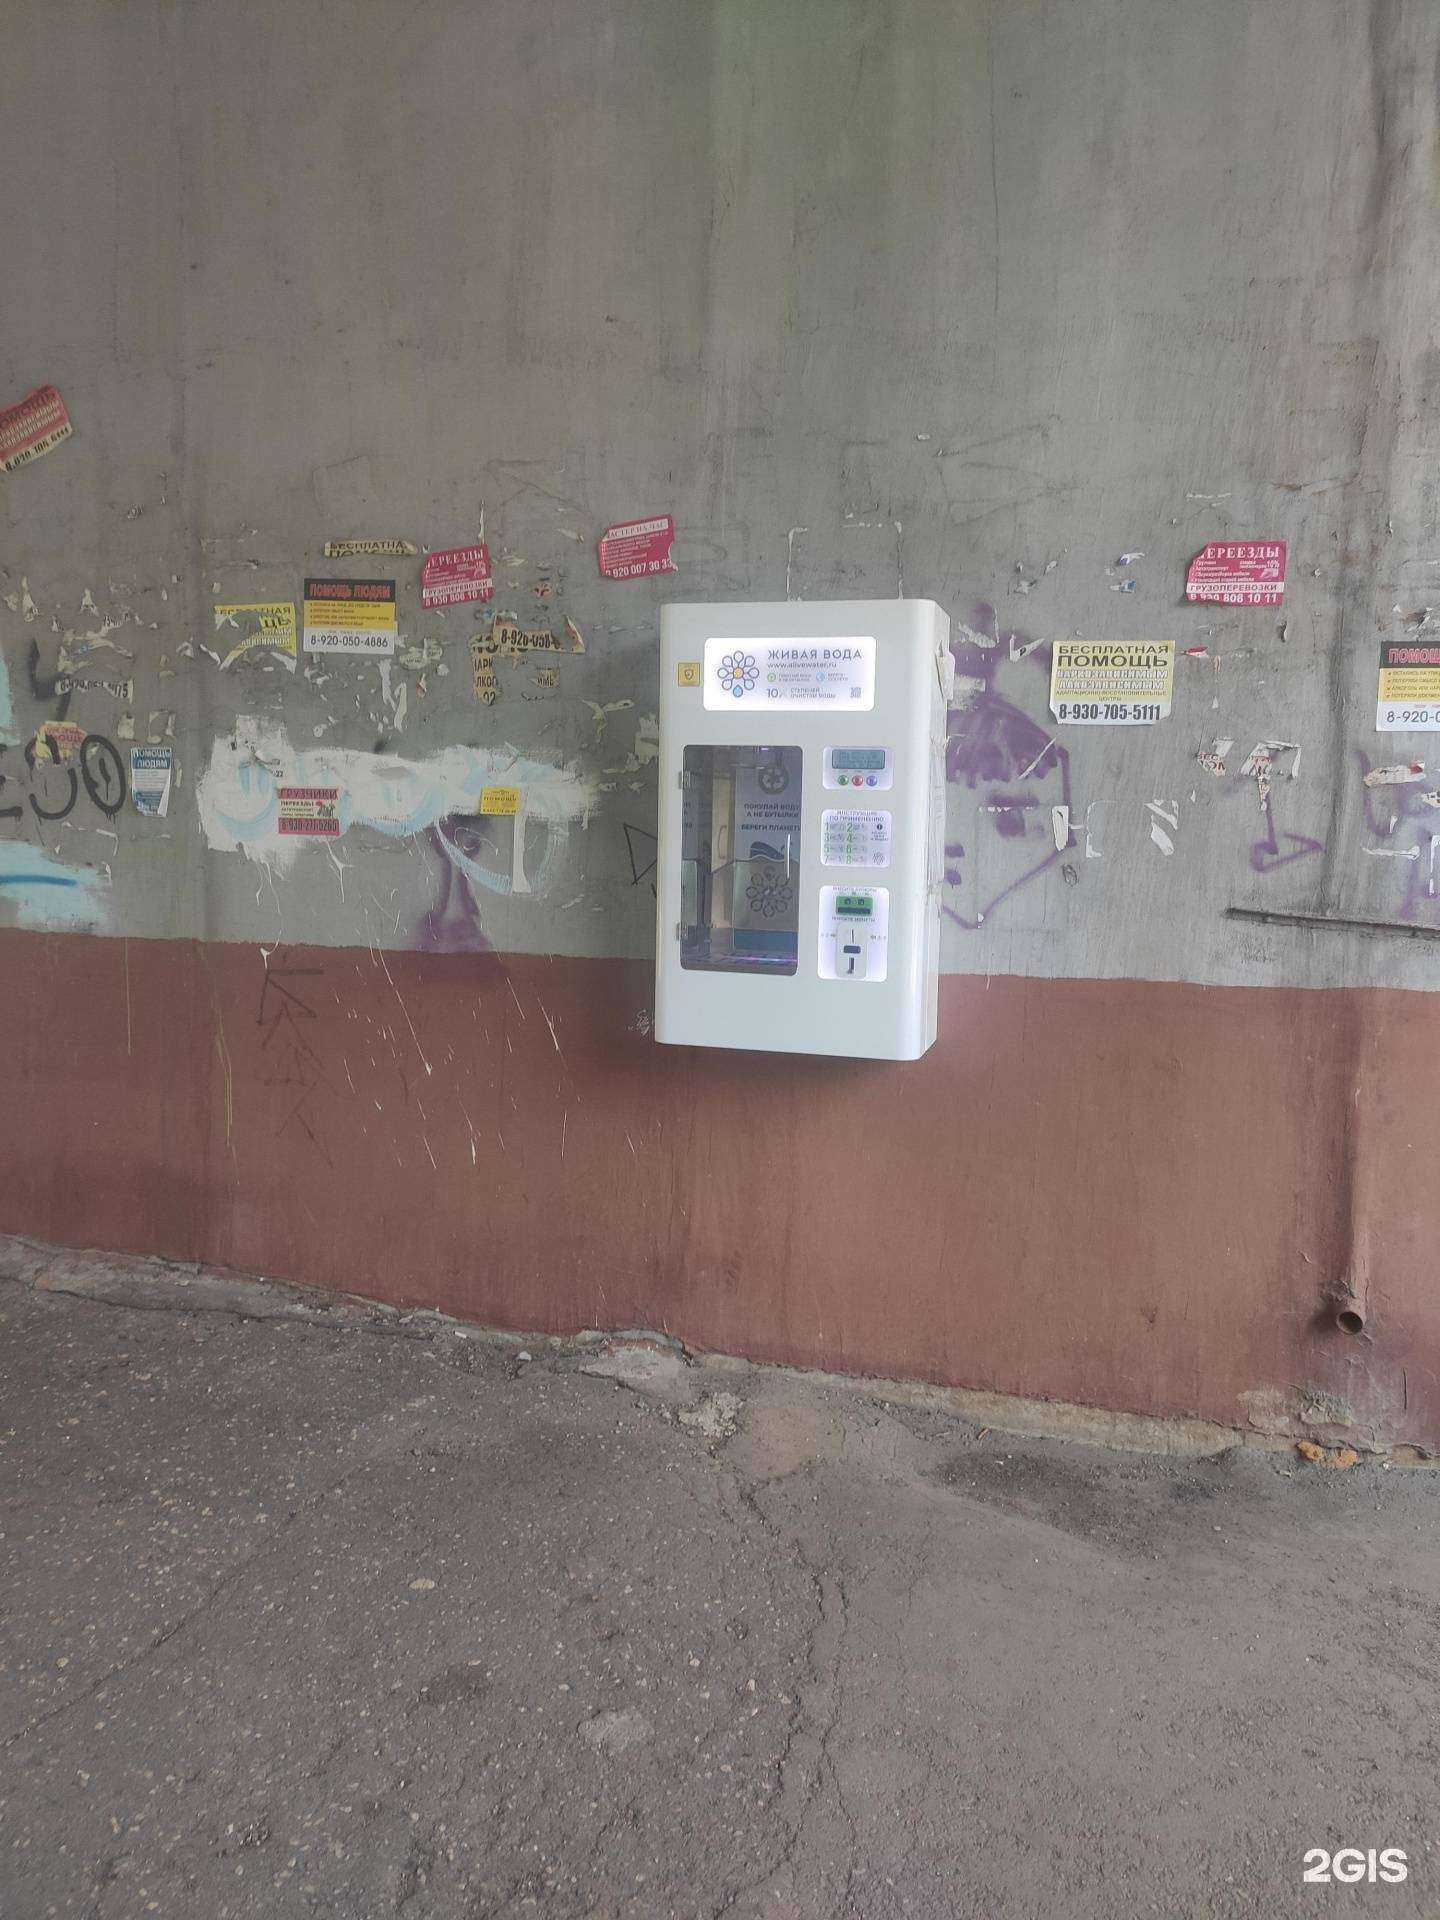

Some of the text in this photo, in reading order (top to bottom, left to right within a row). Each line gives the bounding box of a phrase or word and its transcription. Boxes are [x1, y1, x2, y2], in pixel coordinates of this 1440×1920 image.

[426, 548, 483, 567] ЕРЕЕЗДЫ
[1200, 547, 1280, 559] ЕРЕЕЗДЫ
[612, 567, 630, 578] 920
[649, 560, 660, 571] 30
[309, 583, 391, 599] ПОМОЩЬ ЛЮДЯМ
[1248, 593, 1260, 603] 10
[1265, 593, 1277, 603] 11
[767, 649, 862, 660] ЖИВАЯ ВОДА
[1058, 645, 1168, 654] БЕСПЛАТНАЯ
[1057, 655, 1168, 668] ПОМОЩЬ
[1059, 703, 1161, 720] 8-930-705-5111
[131, 748, 170, 758] ПОМОЩЬ
[137, 759, 168, 768] ЛЮДЯМ
